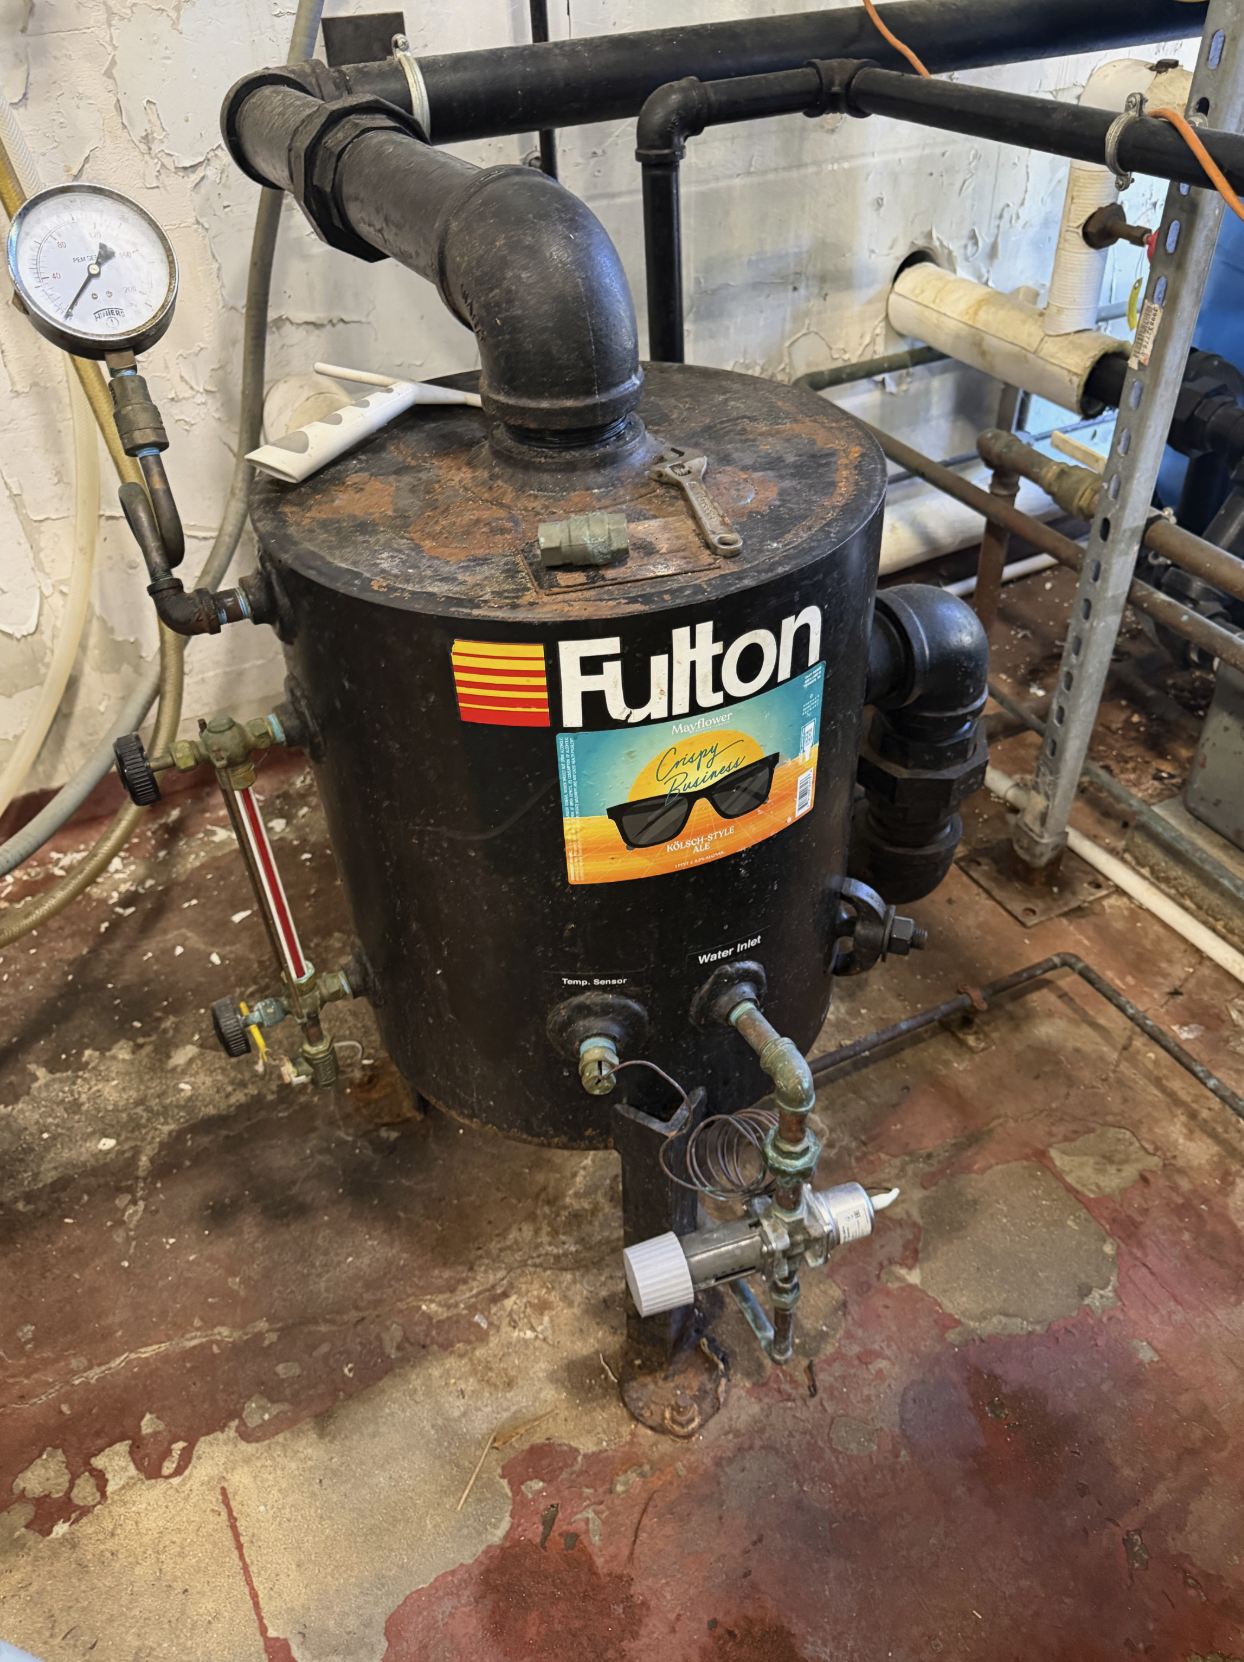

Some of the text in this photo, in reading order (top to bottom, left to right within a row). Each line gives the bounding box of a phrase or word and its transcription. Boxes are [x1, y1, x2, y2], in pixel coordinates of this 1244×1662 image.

[52, 272, 61, 280] 40
[558, 605, 822, 728] Fulton
[671, 712, 733, 735] Mayflower
[656, 739, 744, 782] Crispy
[664, 756, 746, 806] Business
[666, 826, 735, 852] KÖLSCH-STYLE
[692, 842, 711, 854] ALE
[698, 935, 762, 965] Water Inlet
[562, 977, 627, 986] Temp. Sensor
